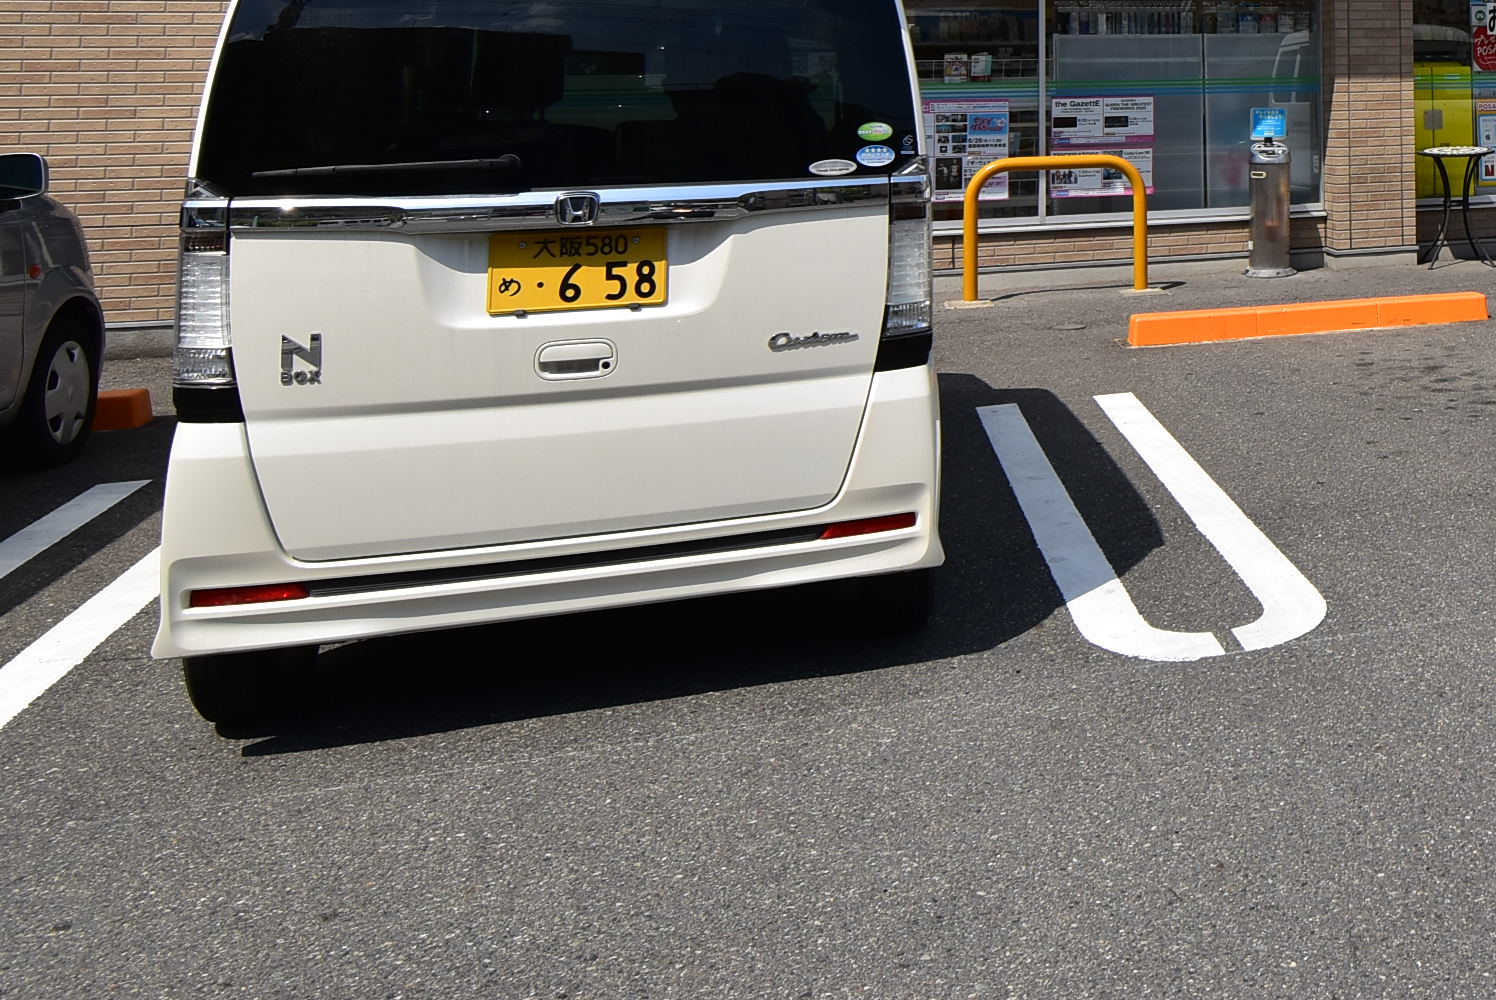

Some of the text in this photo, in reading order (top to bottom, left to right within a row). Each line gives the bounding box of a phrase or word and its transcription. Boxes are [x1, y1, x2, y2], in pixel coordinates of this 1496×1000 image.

[532, 234, 629, 259] 大阪580
[498, 277, 522, 296] め
[281, 333, 322, 370] N
